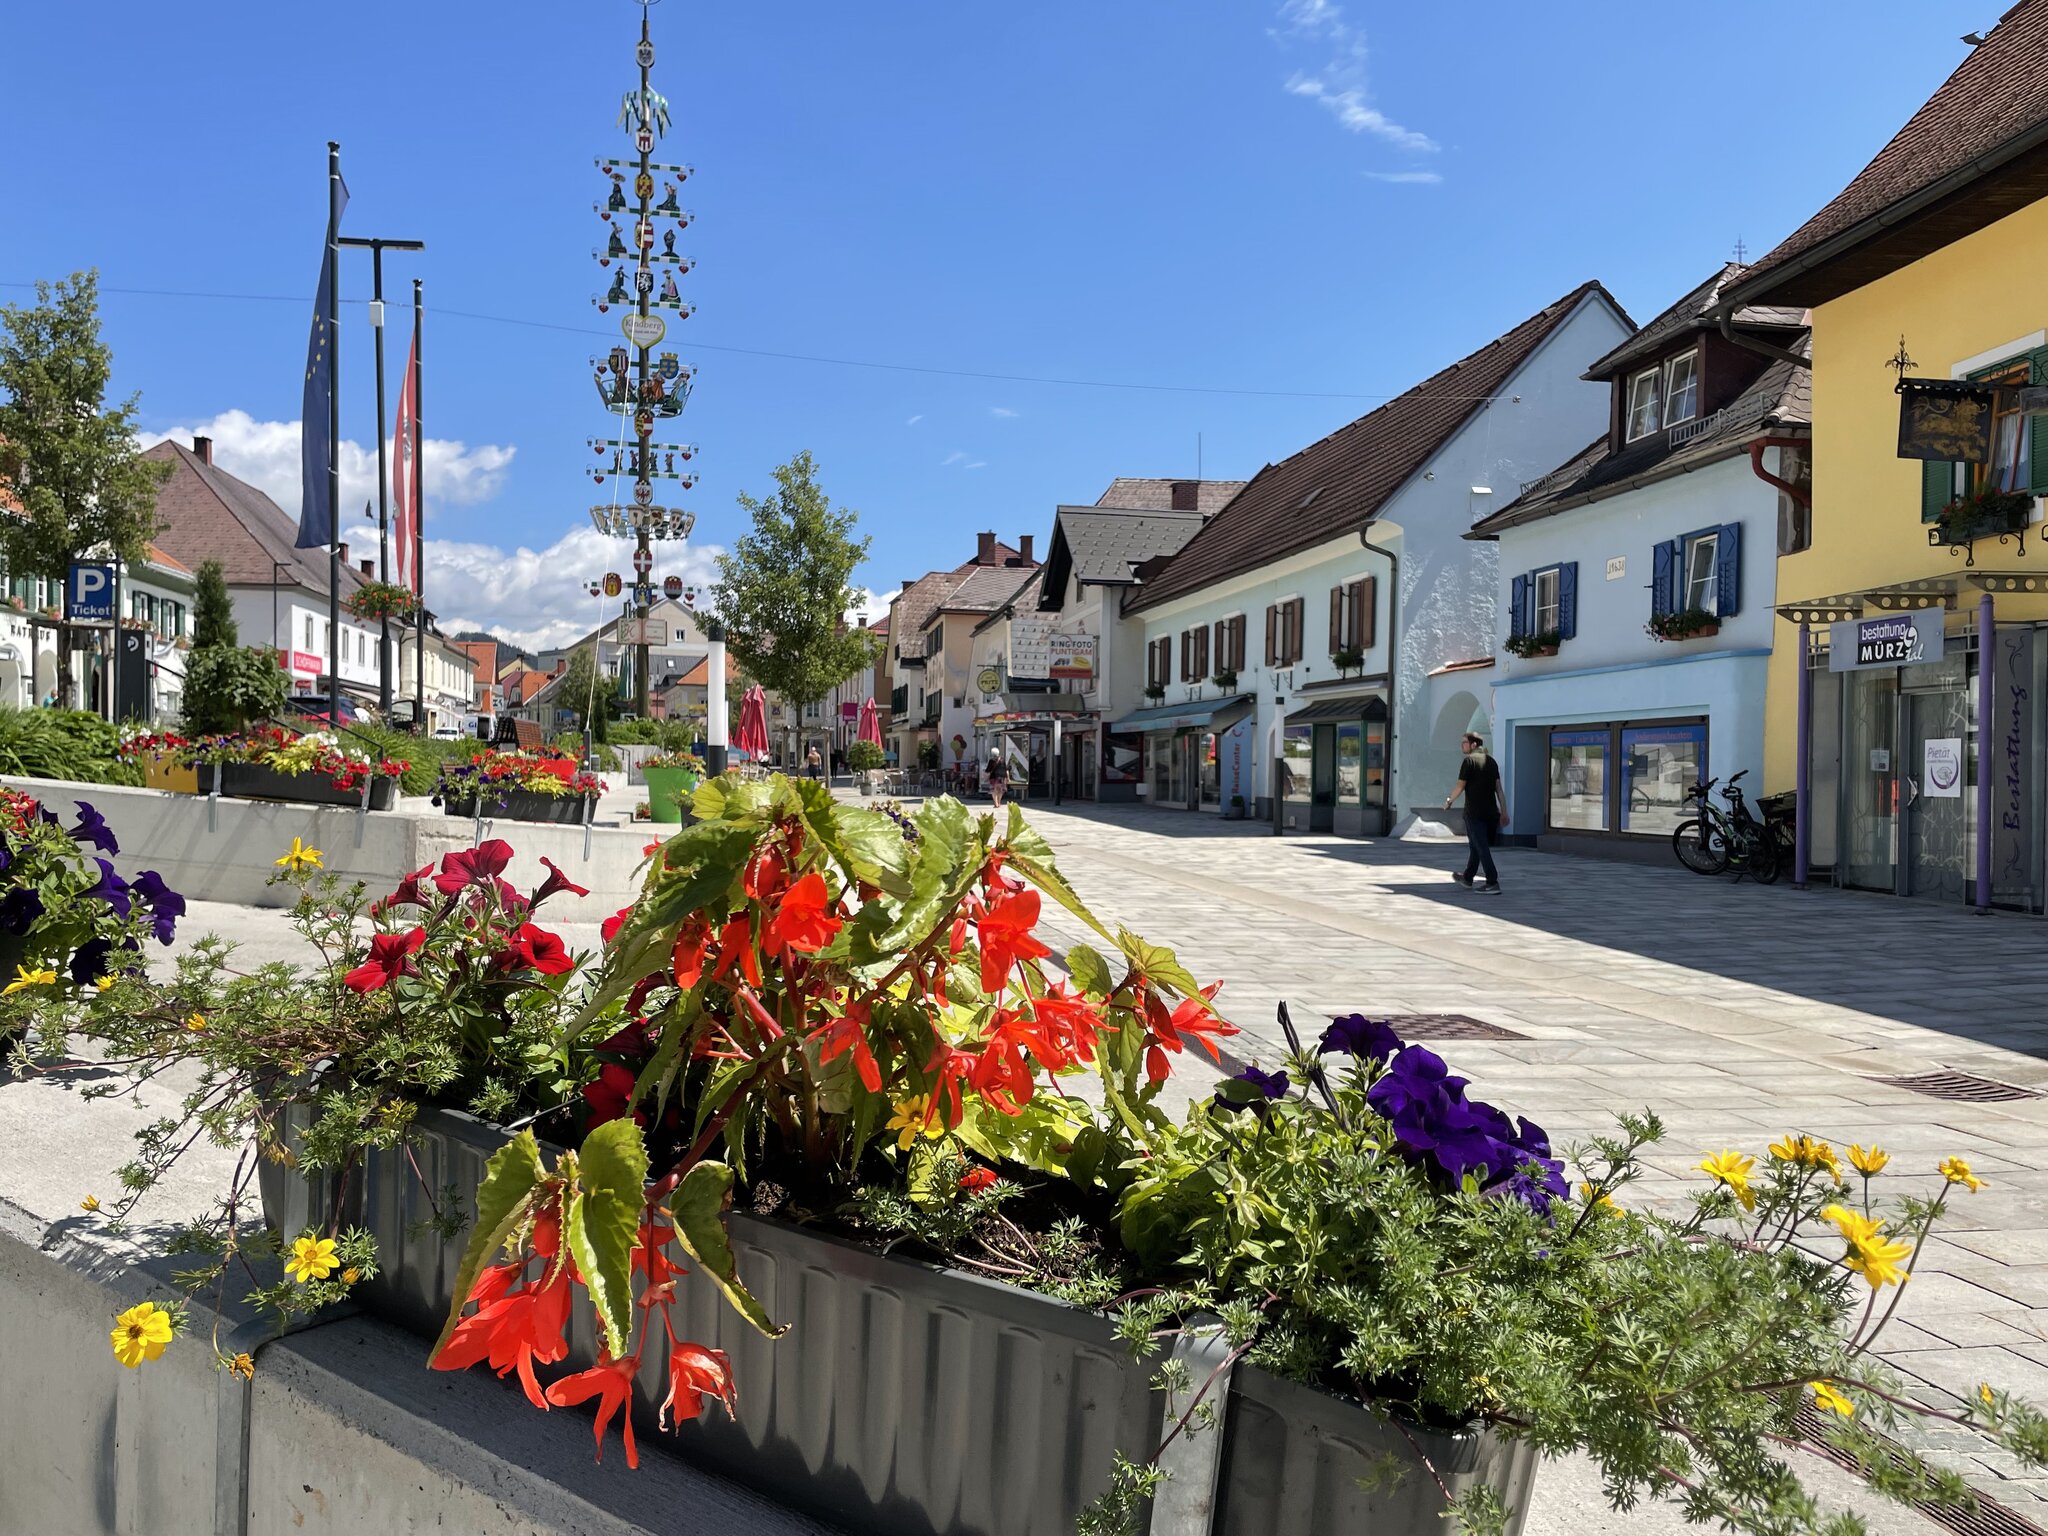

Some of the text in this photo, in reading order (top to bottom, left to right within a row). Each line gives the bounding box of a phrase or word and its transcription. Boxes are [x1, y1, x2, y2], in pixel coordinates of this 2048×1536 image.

[76, 568, 106, 603] P
[72, 604, 110, 616] Ticket
[1861, 623, 1906, 641] bestattung
[1051, 640, 1092, 649] RING FOTO
[1051, 648, 1092, 656] PUNTIGAM
[2003, 685, 2028, 830] Bestattung
